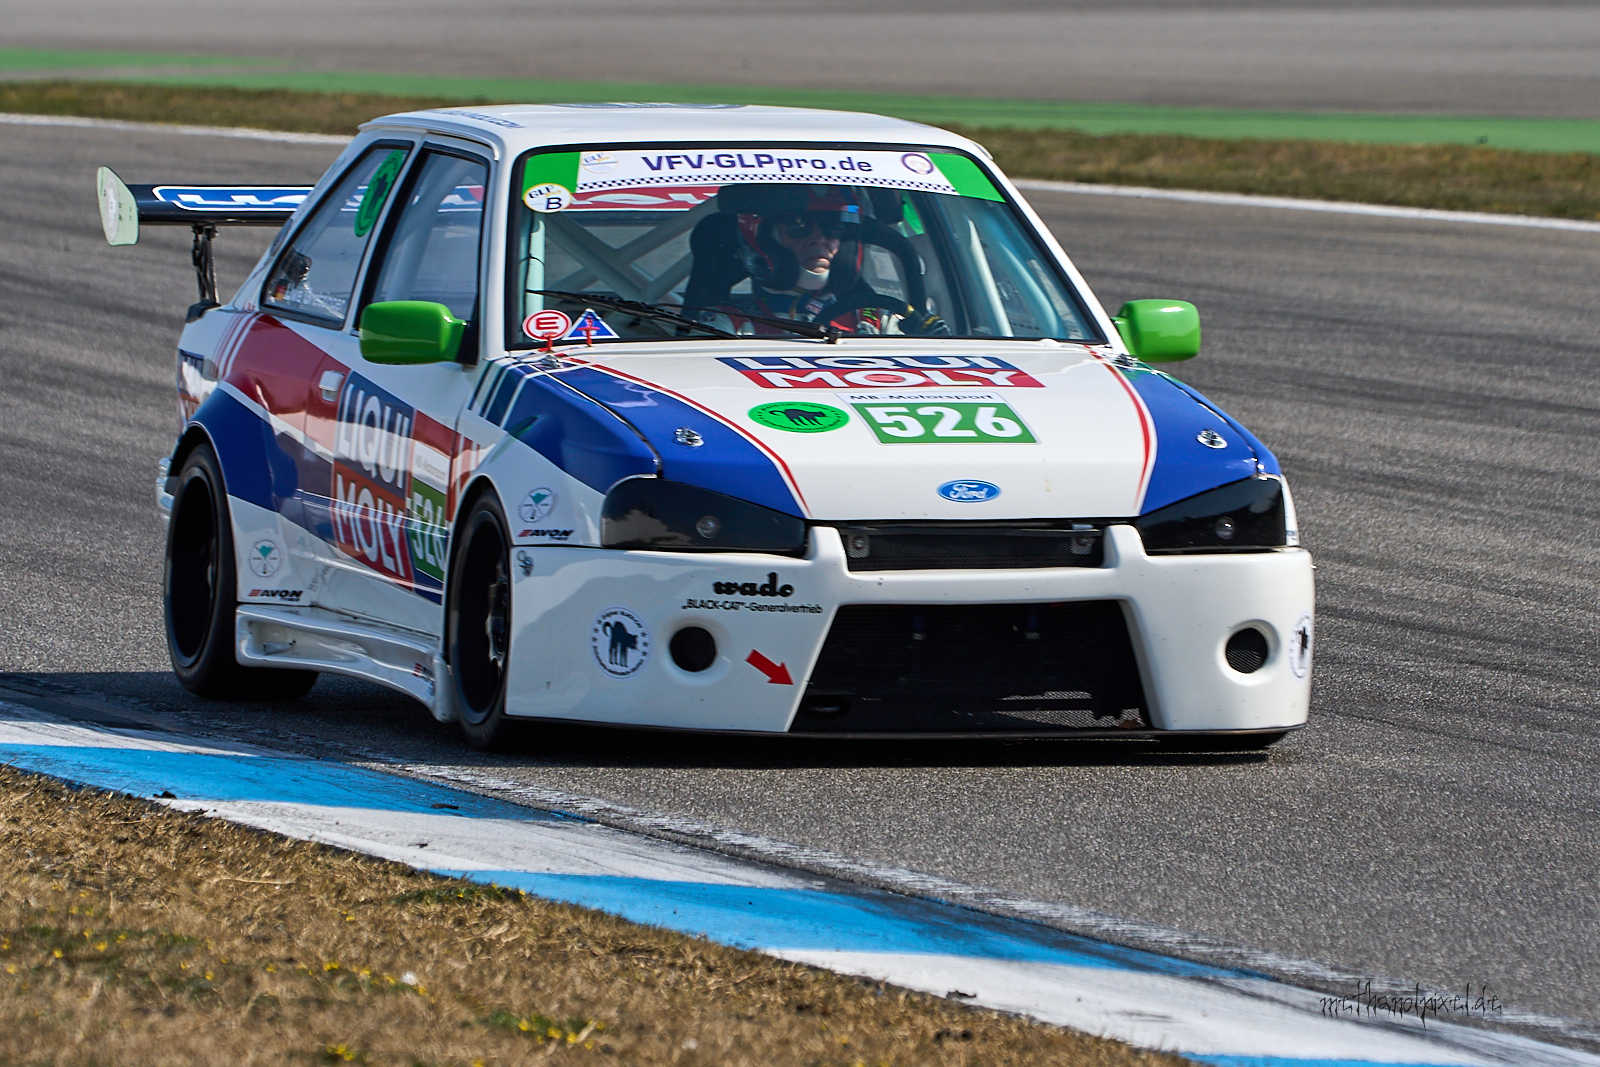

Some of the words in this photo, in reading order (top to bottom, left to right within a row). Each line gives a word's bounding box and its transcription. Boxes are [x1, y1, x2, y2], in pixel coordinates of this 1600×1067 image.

[642, 153, 873, 172] VFV-GLPpro.de
[545, 196, 563, 211] B
[535, 316, 559, 331] E
[734, 357, 1003, 370] LIQUI
[757, 370, 1021, 387] MOLY
[864, 405, 1024, 438] 526
[338, 382, 410, 489] LIQUI
[949, 483, 988, 499] Ford
[335, 472, 407, 578] MOLY
[412, 491, 446, 573] 526
[528, 529, 575, 537] AVON
[260, 589, 305, 598] AVON
